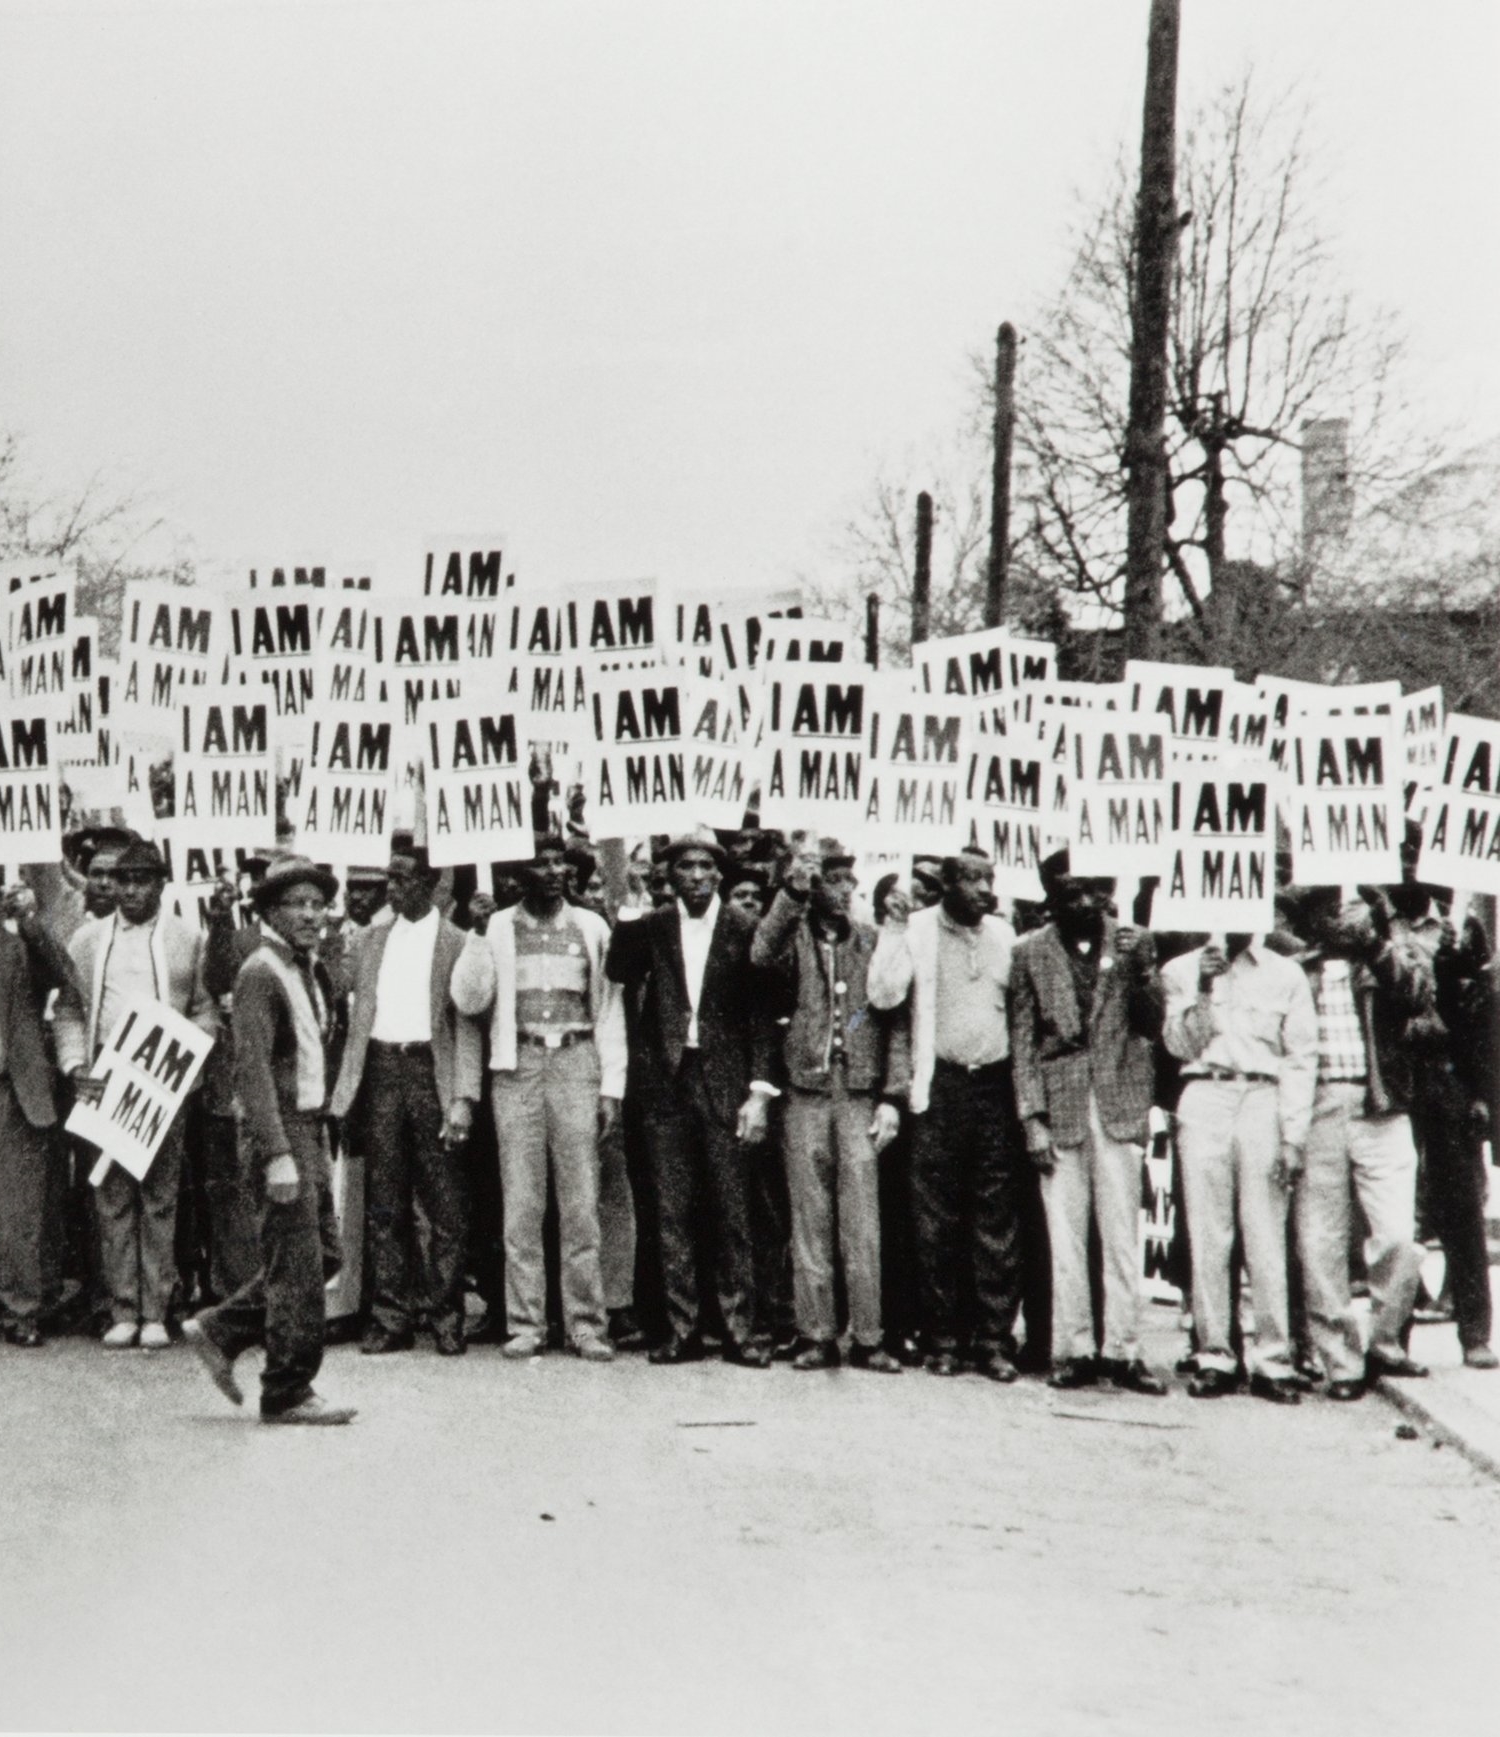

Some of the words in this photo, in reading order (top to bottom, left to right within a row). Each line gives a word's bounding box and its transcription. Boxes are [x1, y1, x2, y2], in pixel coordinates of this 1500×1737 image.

[423, 551, 435, 597] I
[440, 550, 502, 598] AM
[19, 592, 67, 644] AM
[129, 599, 141, 644] I
[148, 603, 212, 655] AM
[230, 607, 243, 656] I
[251, 604, 311, 656] AM
[374, 616, 384, 664] I
[394, 614, 460, 664] AM
[509, 605, 521, 651] I
[567, 601, 579, 650] I
[589, 595, 655, 648] AM
[21, 650, 65, 696] MAN
[124, 659, 139, 704] A
[573, 665, 586, 713] A
[921, 661, 932, 694] I
[944, 647, 1003, 697] AM
[182, 705, 191, 753] I
[202, 703, 268, 754] AM
[592, 692, 604, 742] I
[614, 686, 682, 741] AM
[772, 681, 782, 732] I
[791, 683, 865, 735] AM
[1153, 685, 1224, 738] AM
[310, 720, 321, 769] I
[327, 721, 392, 770] AM
[428, 721, 441, 770] I
[452, 713, 518, 769] AM
[869, 711, 880, 760] I
[890, 712, 962, 764] AM
[1074, 732, 1084, 781] I
[1097, 732, 1165, 781] AM
[1294, 736, 1305, 786] I
[1316, 737, 1384, 787] AM
[1442, 735, 1460, 786] I
[183, 770, 197, 817] A
[211, 769, 268, 817] MAN
[599, 757, 615, 806] A
[625, 752, 686, 804] MAN
[769, 748, 785, 798] A
[798, 749, 862, 801] MAN
[965, 752, 979, 801] I
[984, 755, 1041, 809] AM
[304, 785, 318, 832] A
[330, 786, 387, 836] MAN
[437, 787, 452, 834] A
[462, 780, 523, 832] MAN
[865, 777, 880, 820] A
[895, 778, 957, 825] MAN
[1079, 798, 1094, 844] A
[1107, 797, 1163, 845] MAN
[1171, 781, 1182, 832] I
[1192, 781, 1267, 834] AM
[992, 819, 1041, 870] MAN
[1301, 804, 1314, 851] A
[1326, 803, 1389, 851] MAN
[1430, 803, 1449, 853] A
[1170, 849, 1186, 898] A
[1201, 849, 1265, 900] MAN
[113, 1010, 139, 1054] I
[130, 1023, 197, 1094] AM
[111, 1080, 169, 1149] MAN
